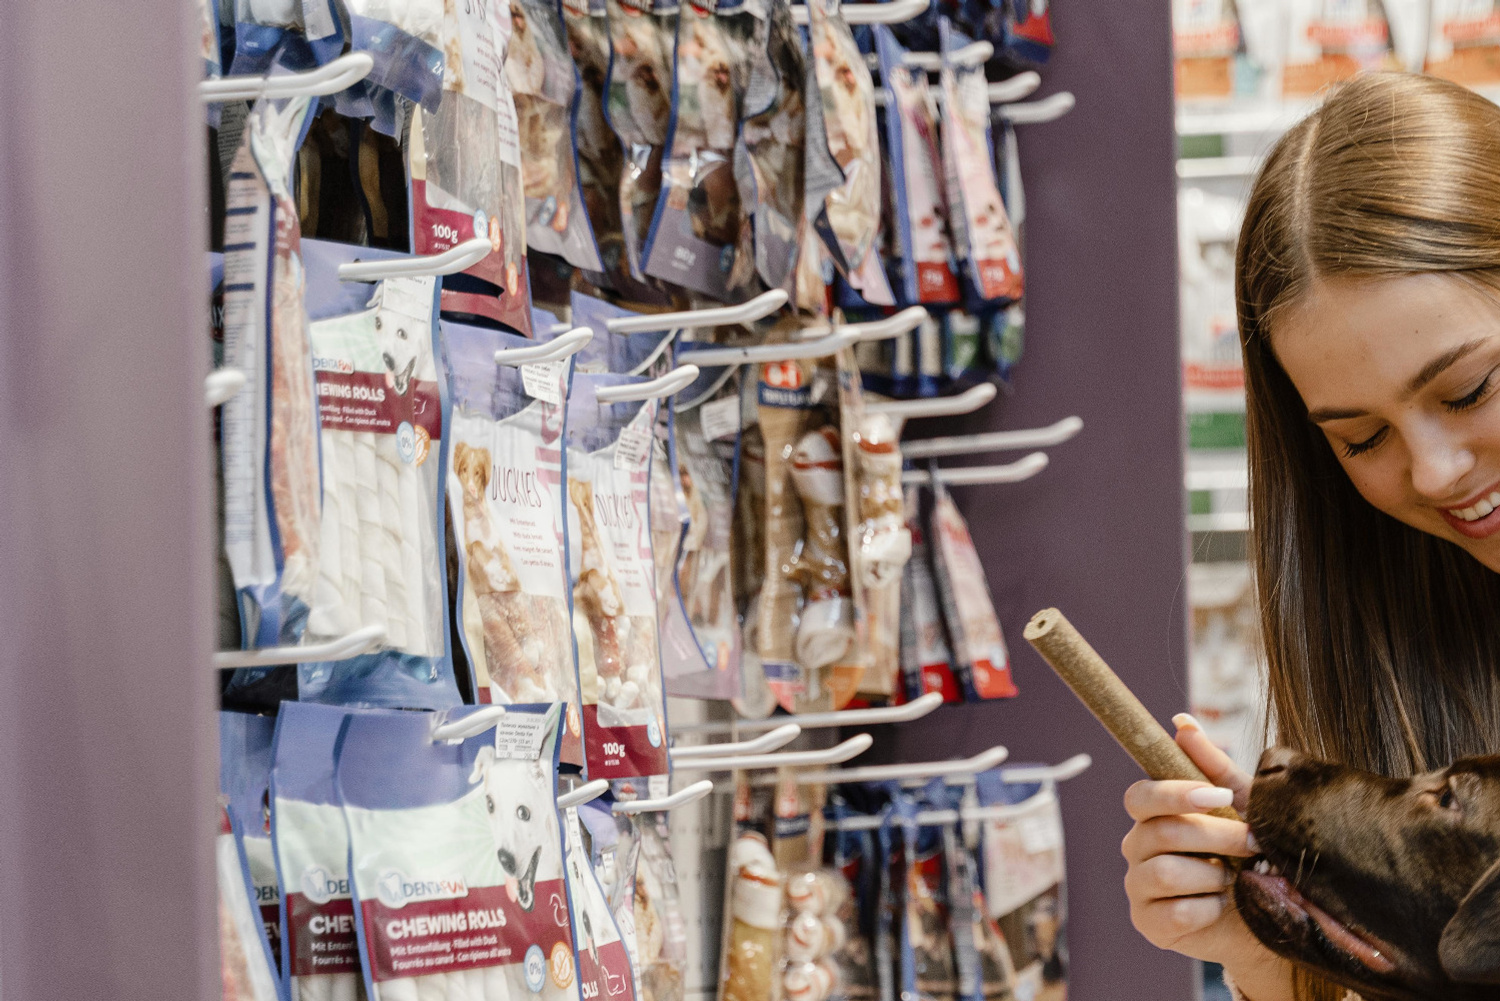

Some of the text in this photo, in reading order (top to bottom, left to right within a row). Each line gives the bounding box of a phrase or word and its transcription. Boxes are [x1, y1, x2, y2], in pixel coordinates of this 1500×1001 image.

[432, 223, 459, 244] 100g
[353, 386, 386, 403] ROLLS
[491, 464, 542, 508] DUCKIES
[602, 742, 626, 758] 100g
[403, 879, 465, 898] DENTAFUN
[386, 907, 507, 940] CHEWING ROLLS
[389, 944, 407, 958] Mit
[483, 934, 498, 947] Duck
